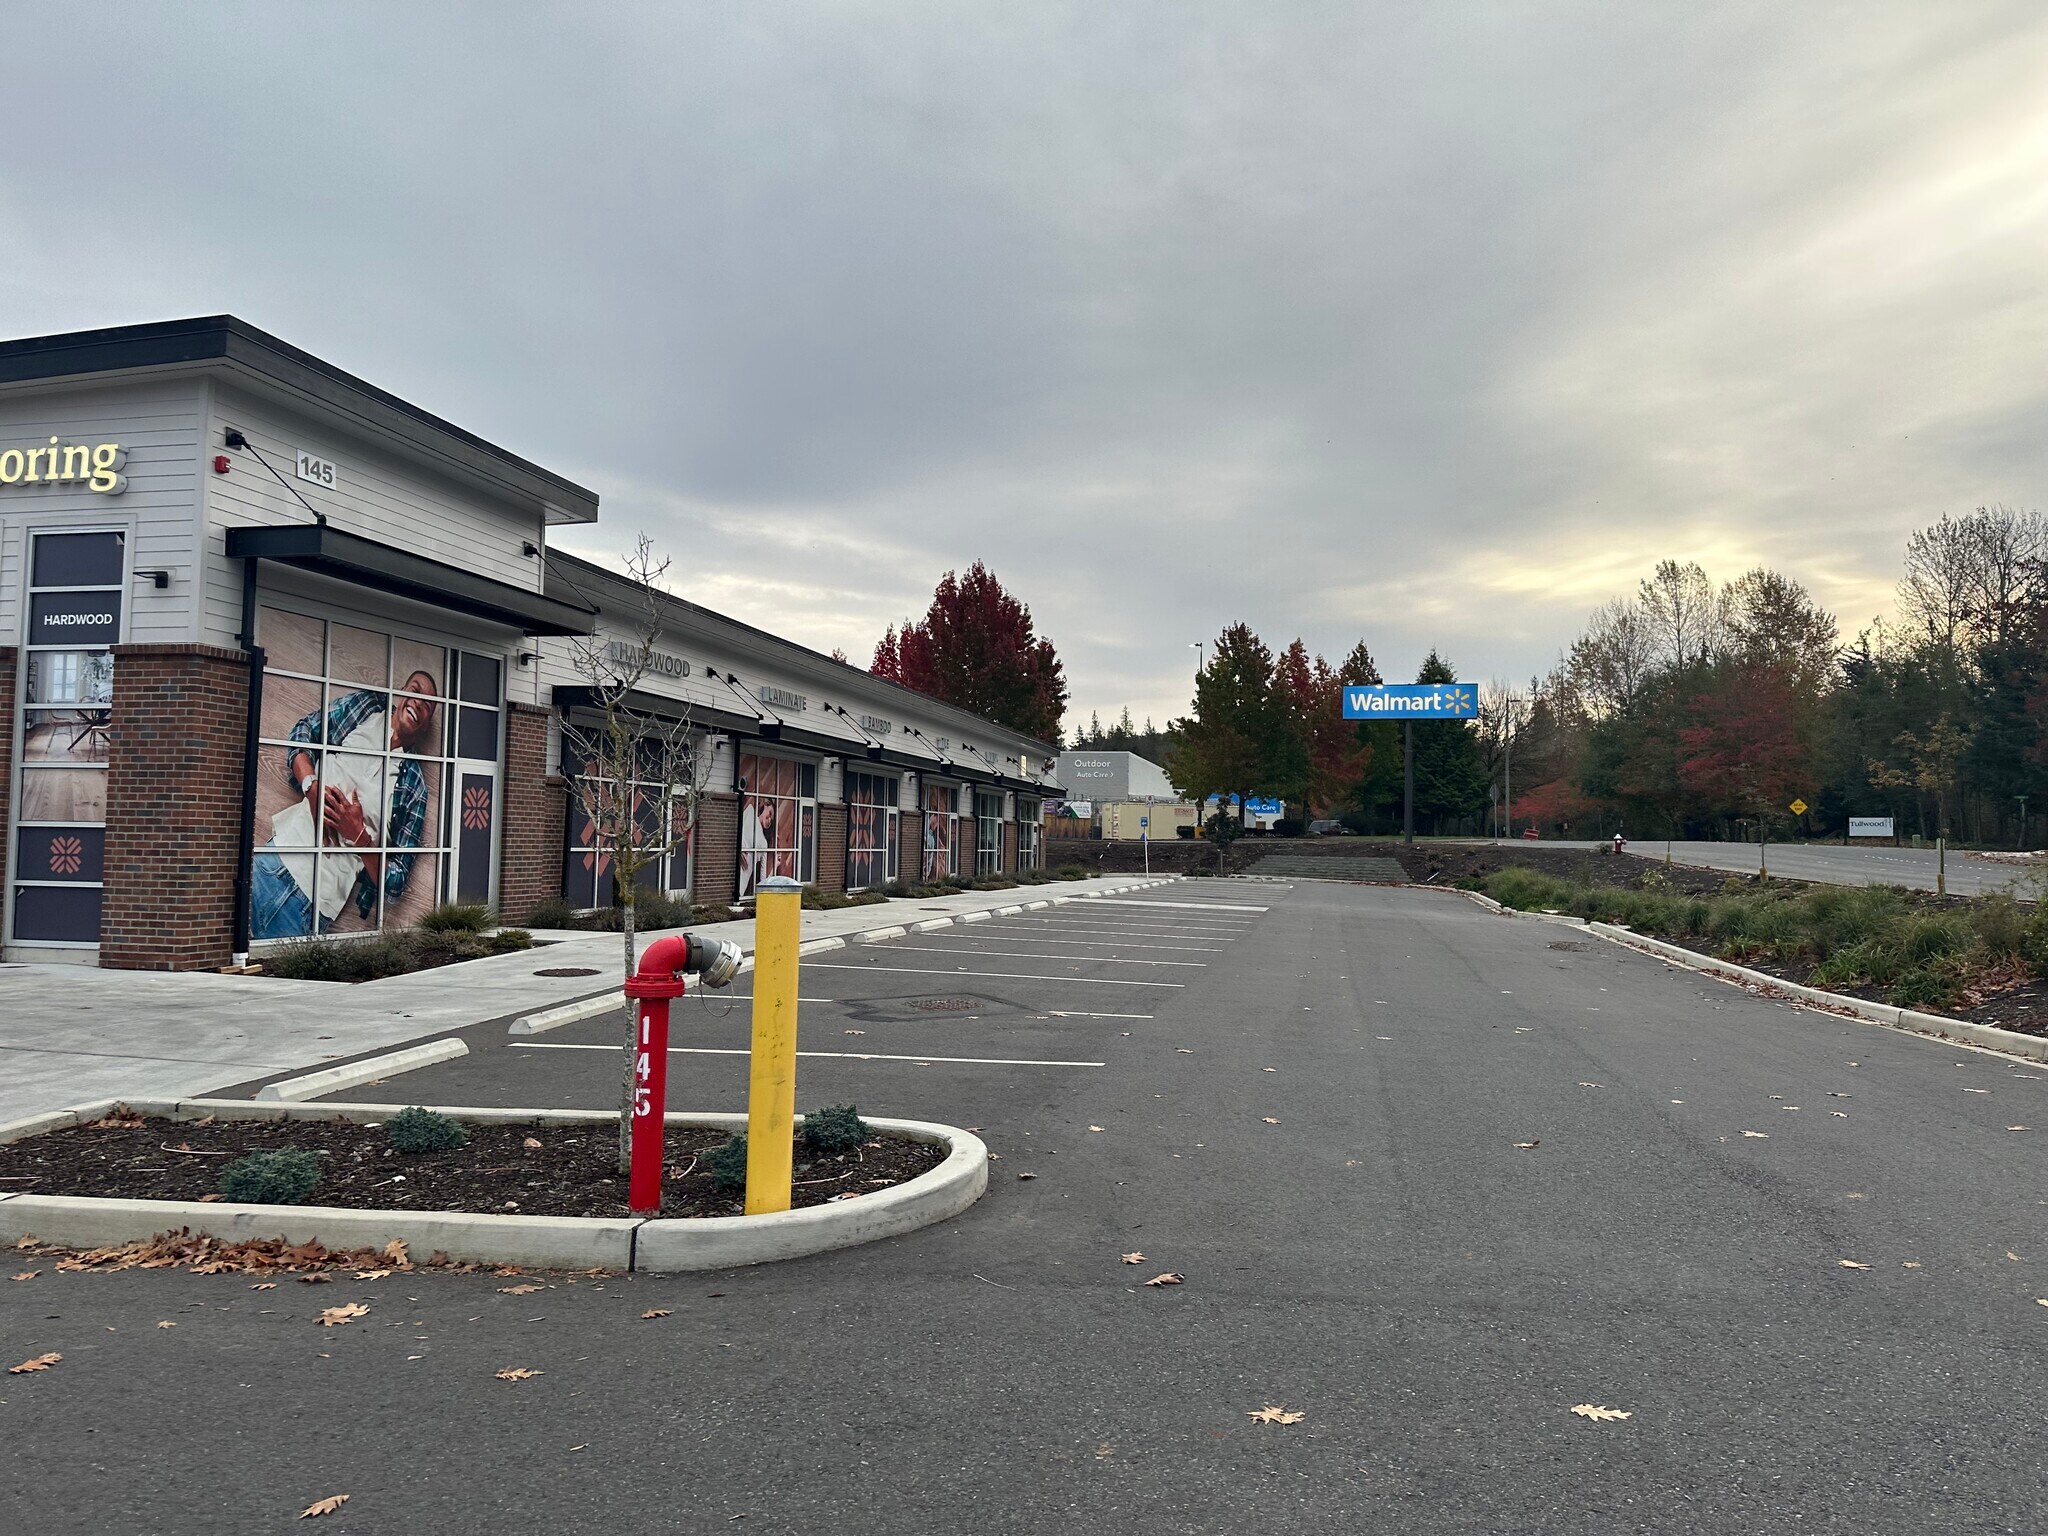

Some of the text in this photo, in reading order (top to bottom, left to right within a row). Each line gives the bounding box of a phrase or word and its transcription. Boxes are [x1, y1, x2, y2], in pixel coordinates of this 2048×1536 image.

[0, 436, 119, 492] oring
[300, 456, 333, 484] 145
[44, 613, 113, 626] HARDWOOD
[768, 686, 807, 711] LAMINATE
[1350, 692, 1441, 711] Walmart
[868, 715, 892, 734] BAMBOO
[1074, 759, 1111, 768] Outdoor
